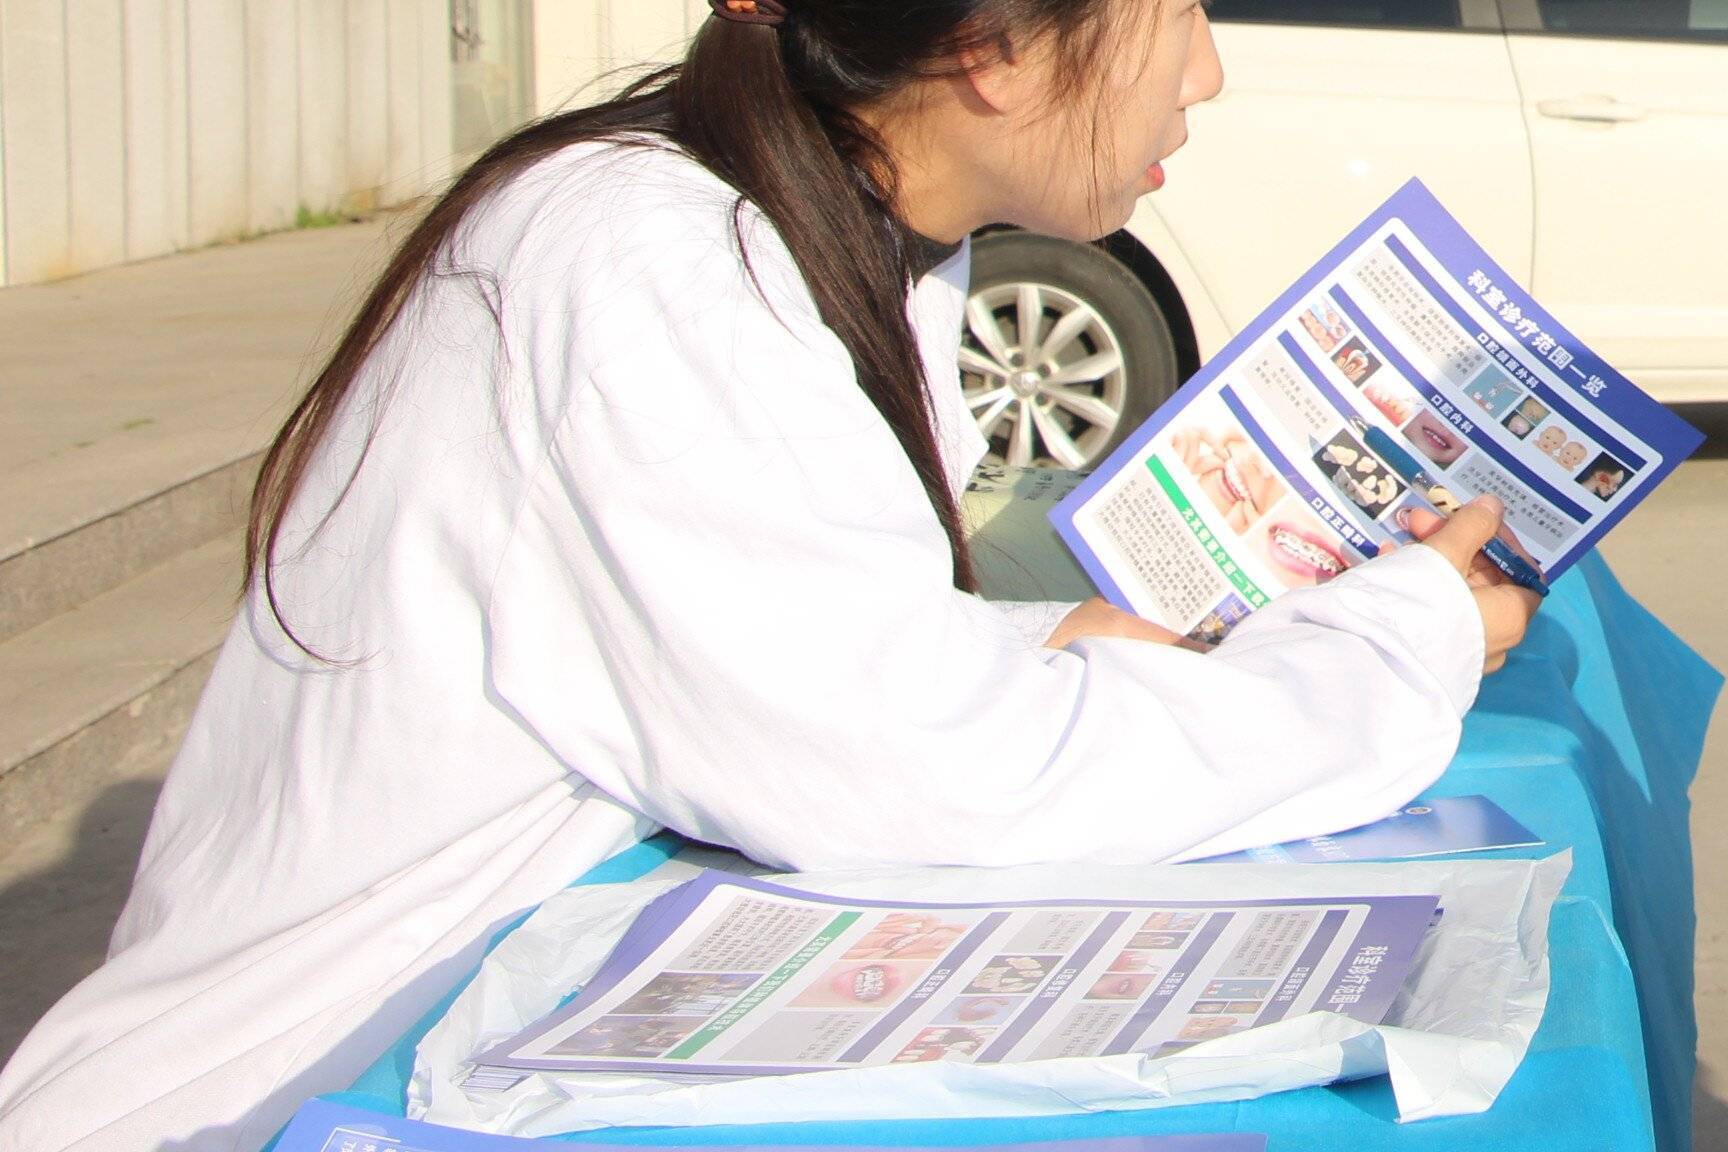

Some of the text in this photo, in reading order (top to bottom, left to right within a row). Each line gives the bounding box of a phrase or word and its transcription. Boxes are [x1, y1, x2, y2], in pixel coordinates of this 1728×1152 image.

[1467, 269, 1607, 397] 科室诊疗范围一览
[1477, 332, 1539, 389] 口腔颌面外科
[1431, 394, 1474, 433] 口腔内科
[1312, 498, 1365, 547] 口腔正畸科
[1183, 508, 1266, 607] 尤其需要介绍一下我
[1155, 973, 1185, 996] 口腔内科
[1328, 946, 1389, 1013] 科室诊疗范围一
